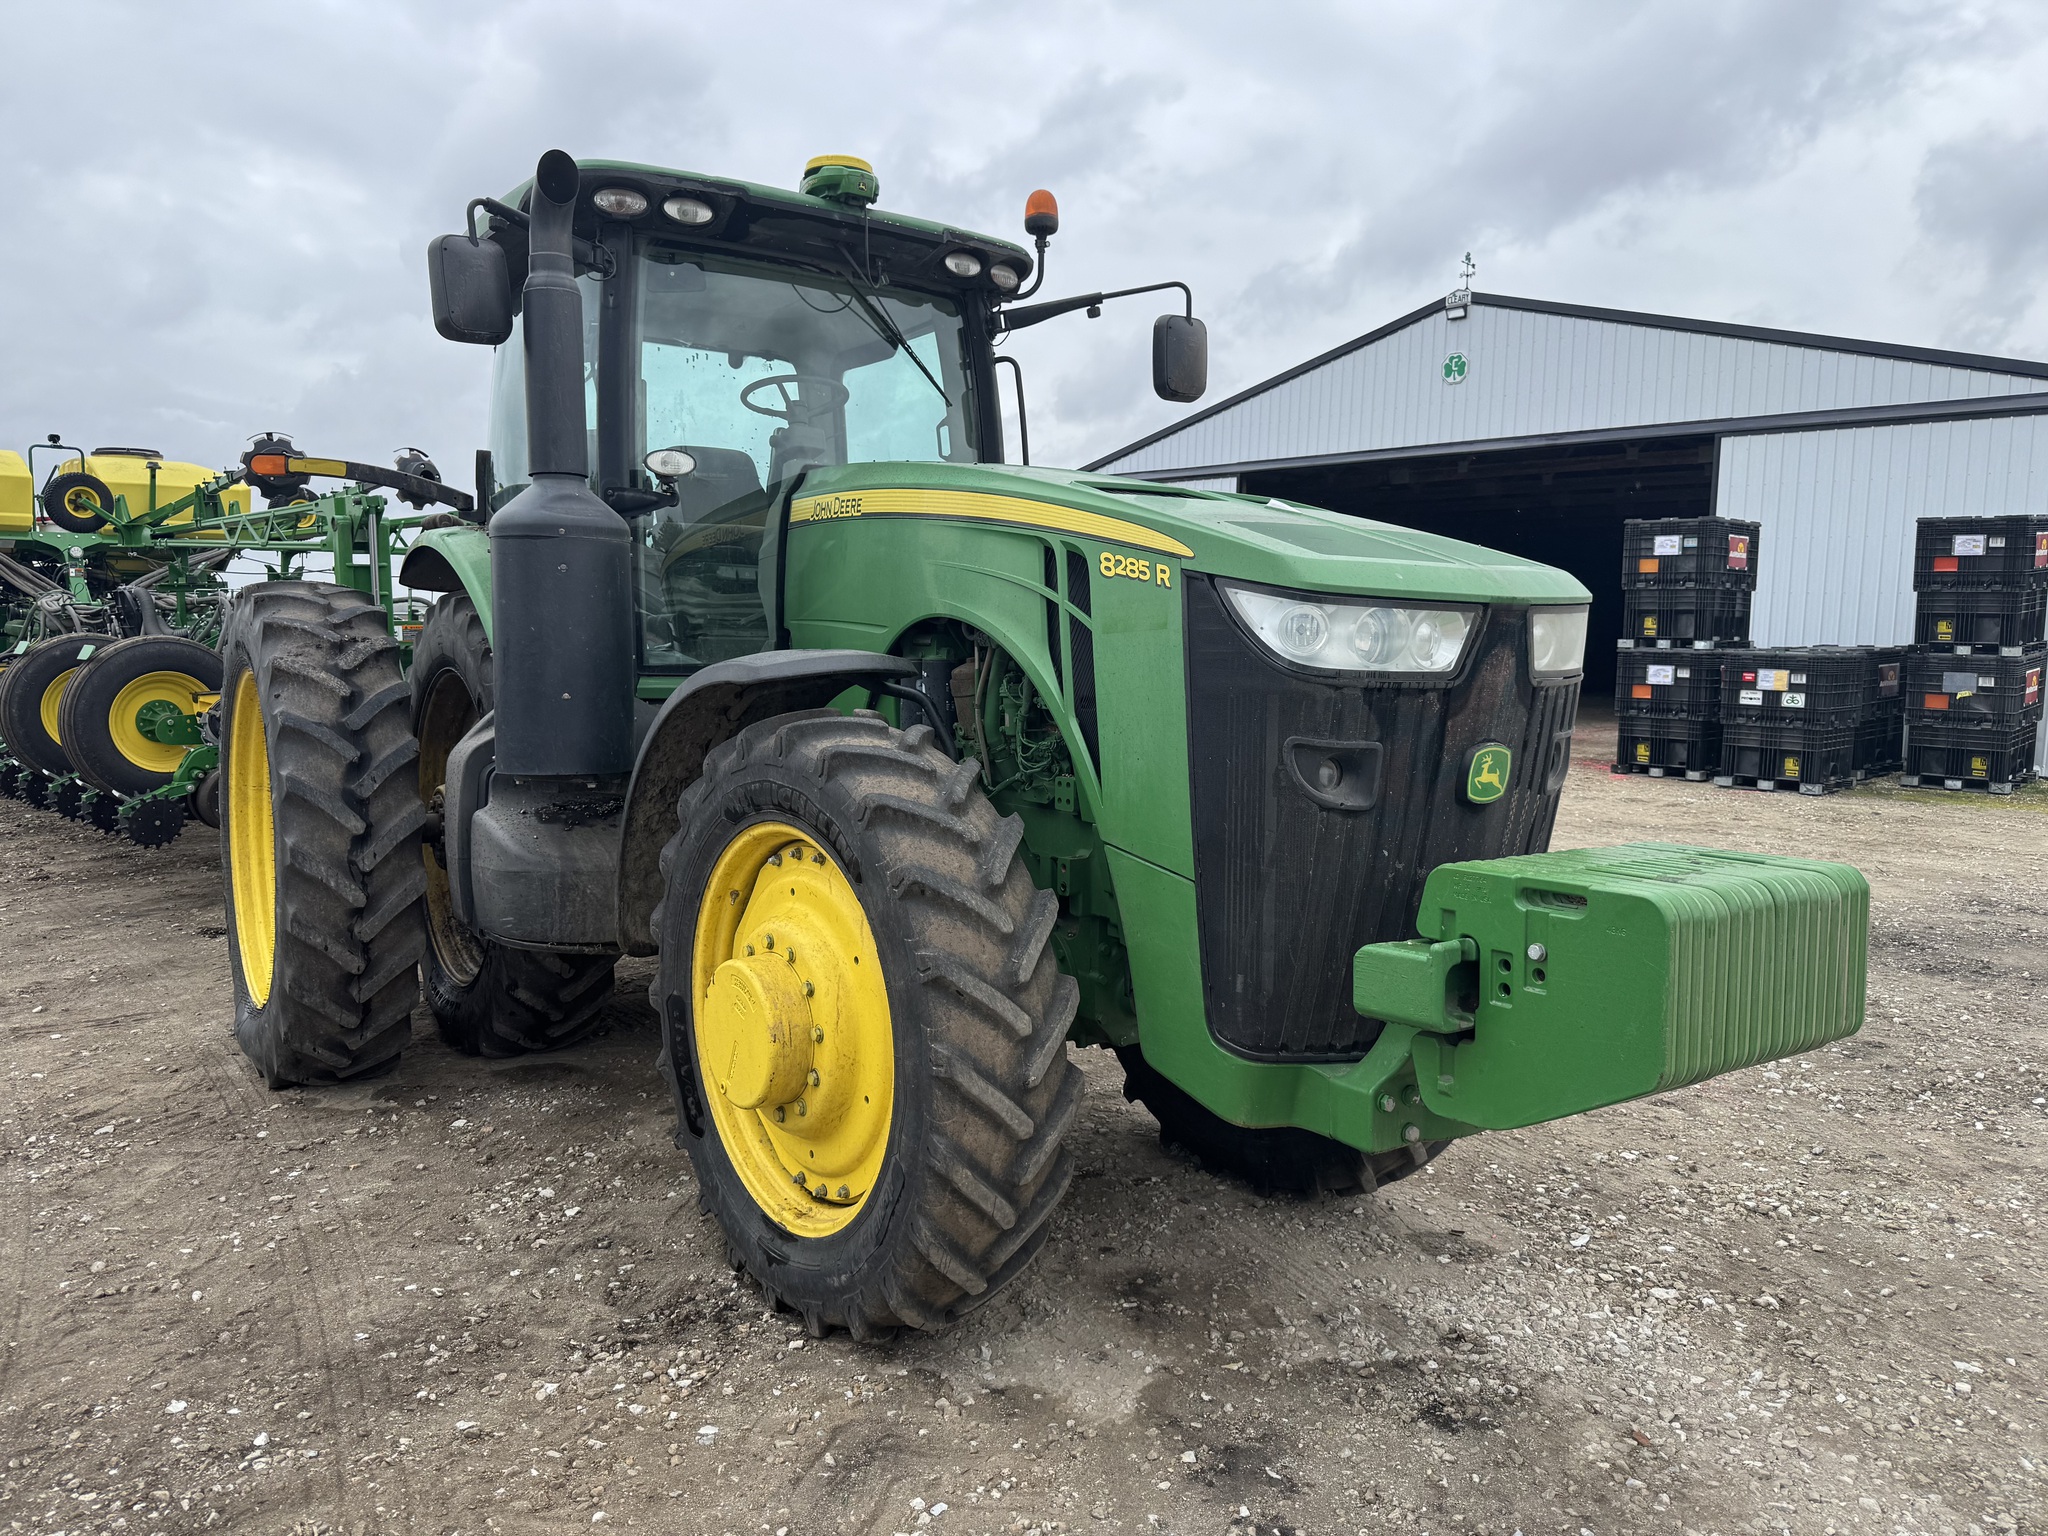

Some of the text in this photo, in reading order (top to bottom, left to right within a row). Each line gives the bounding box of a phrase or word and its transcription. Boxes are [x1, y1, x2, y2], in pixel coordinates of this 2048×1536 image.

[1447, 294, 1470, 305] CLEARY
[810, 497, 863, 519] JOHN DEERE
[1100, 551, 1172, 589] 8285 R
